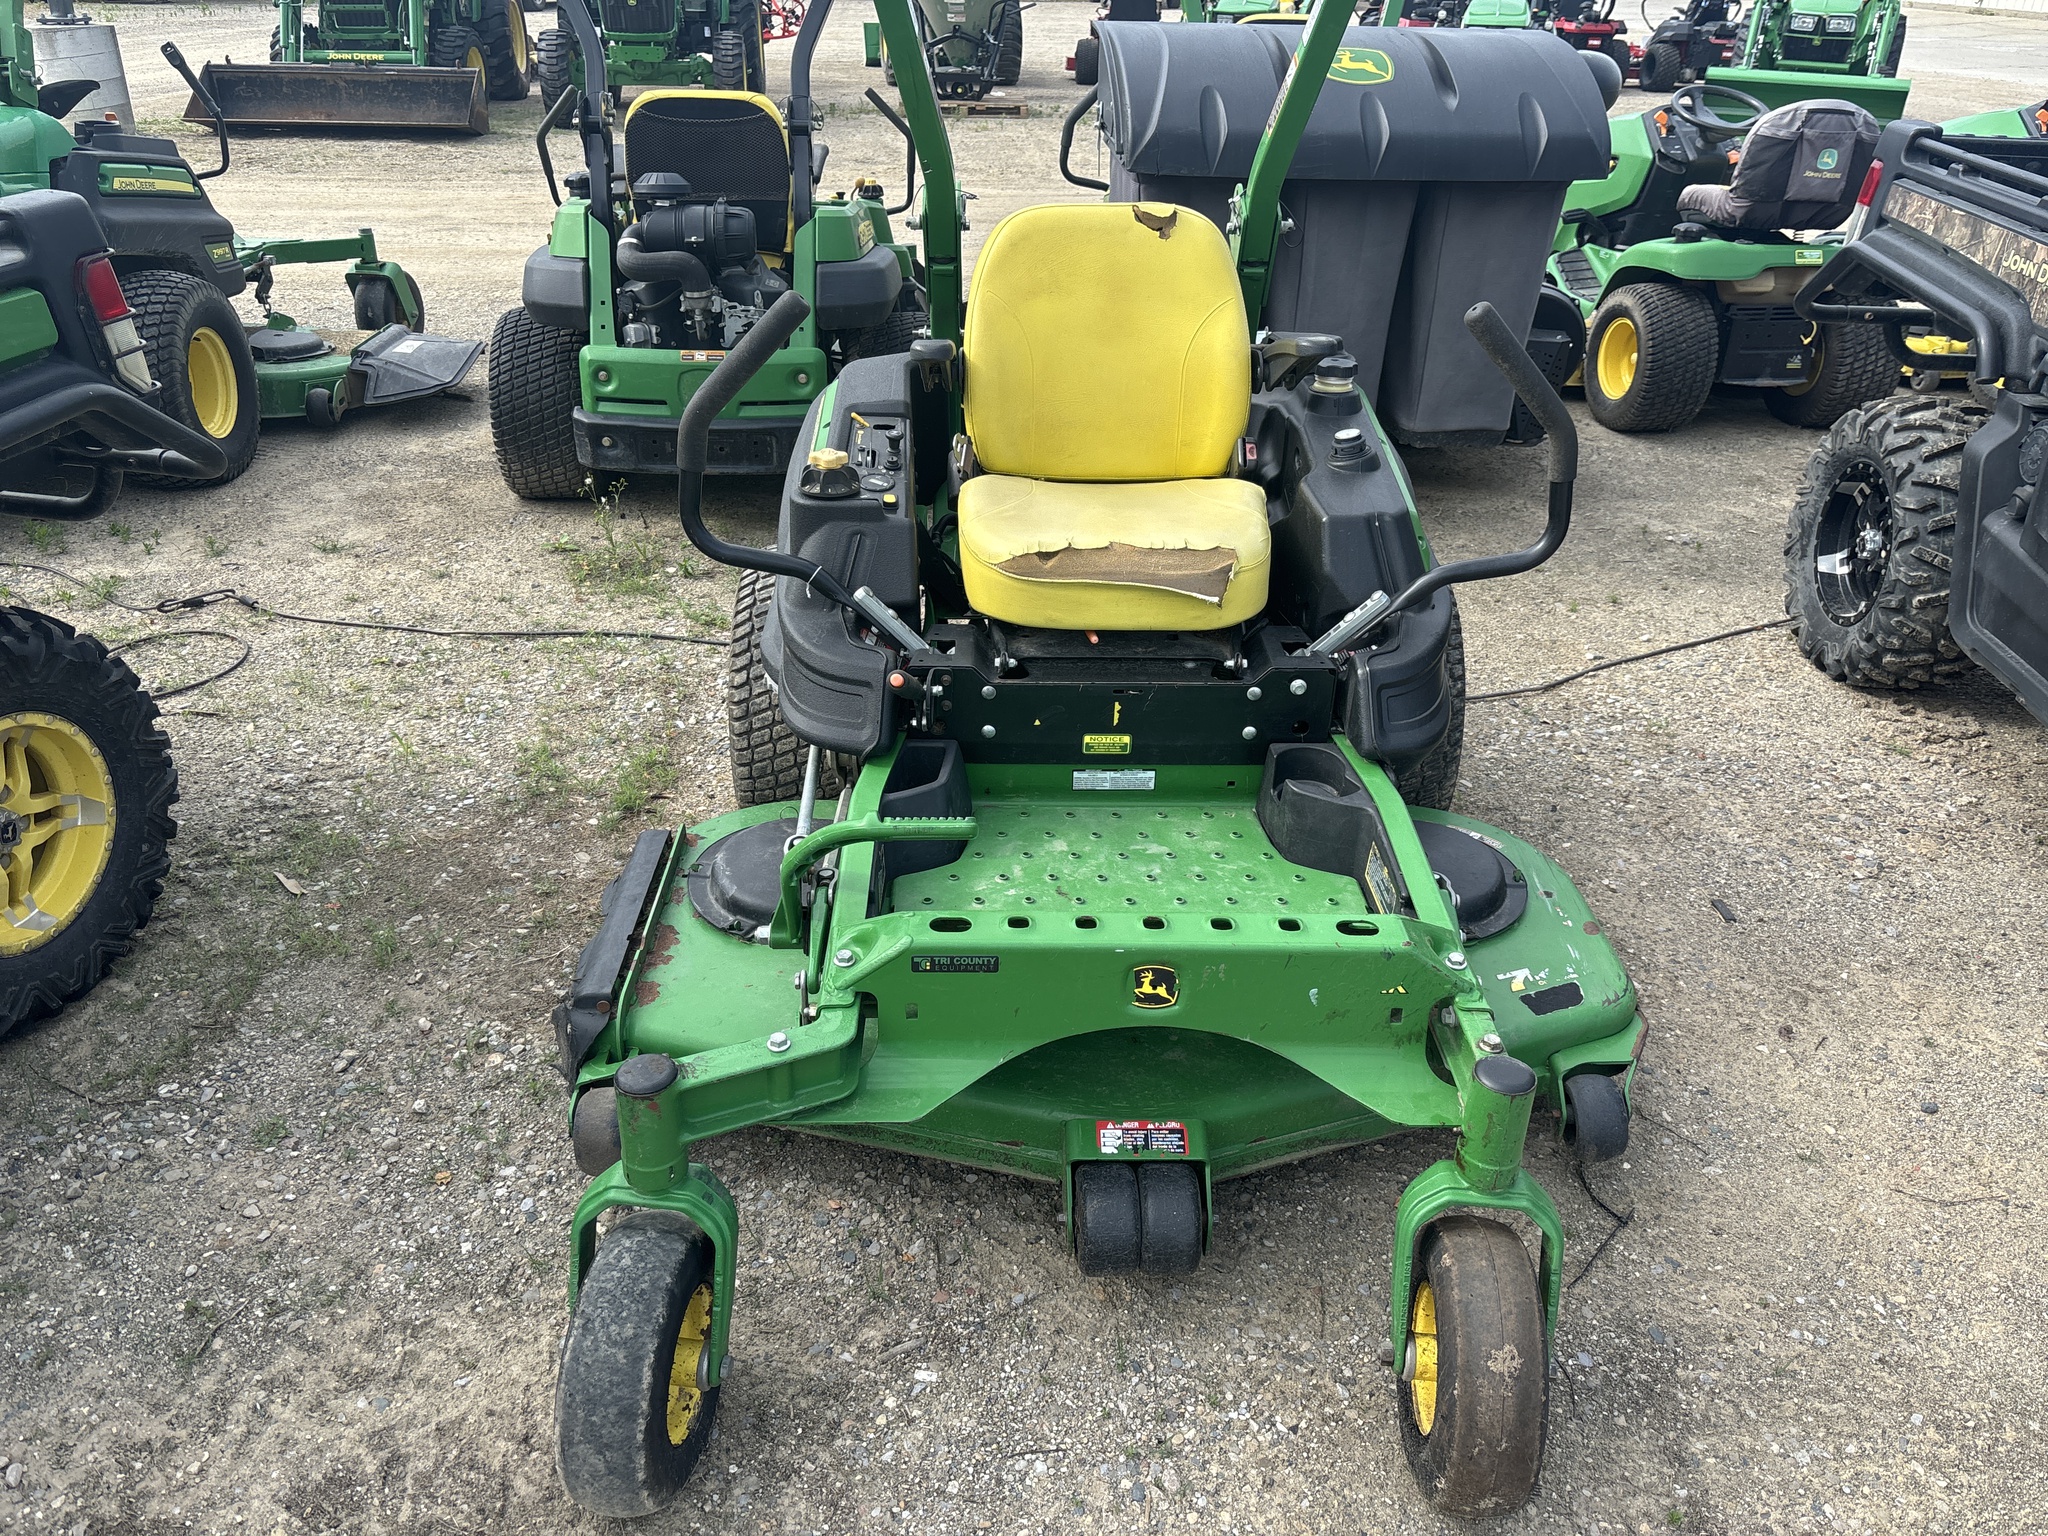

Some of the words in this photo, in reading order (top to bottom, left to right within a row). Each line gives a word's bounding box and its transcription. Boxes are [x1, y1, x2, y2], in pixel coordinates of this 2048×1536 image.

[353, 53, 385, 61] DEERE
[1802, 170, 1822, 178] JOHN
[118, 179, 136, 189] JOHN
[135, 180, 157, 190] DEERE
[2002, 249, 2039, 279] JOHN
[933, 957, 951, 965] TRI
[953, 957, 997, 965] COUNTY
